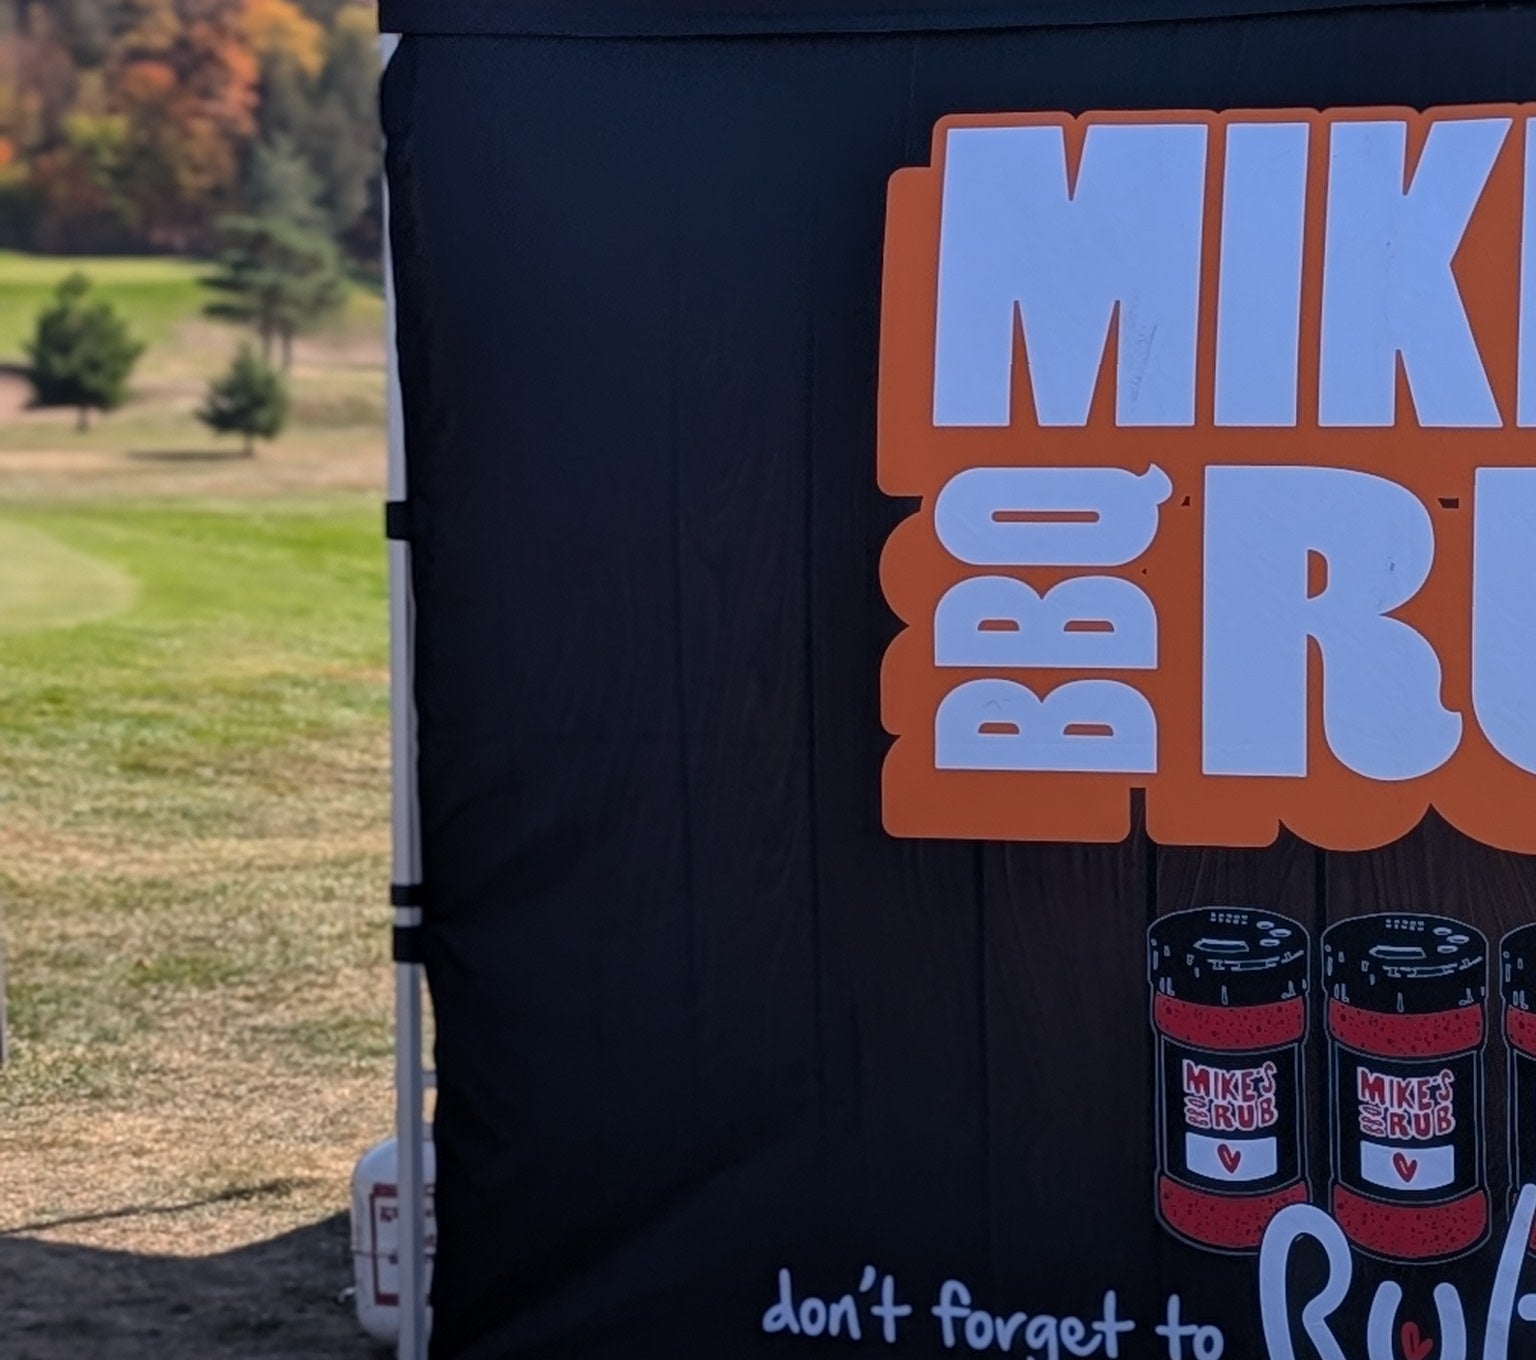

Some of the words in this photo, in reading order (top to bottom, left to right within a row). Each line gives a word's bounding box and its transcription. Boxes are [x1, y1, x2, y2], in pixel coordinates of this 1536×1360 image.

[933, 462, 1174, 775] BBQ
[1182, 1059, 1277, 1104] MIKE'S
[1357, 1067, 1454, 1112] MIKE'S
[1212, 1095, 1278, 1131] RUB
[1388, 1102, 1456, 1140] RUB
[762, 1266, 912, 1342] don't
